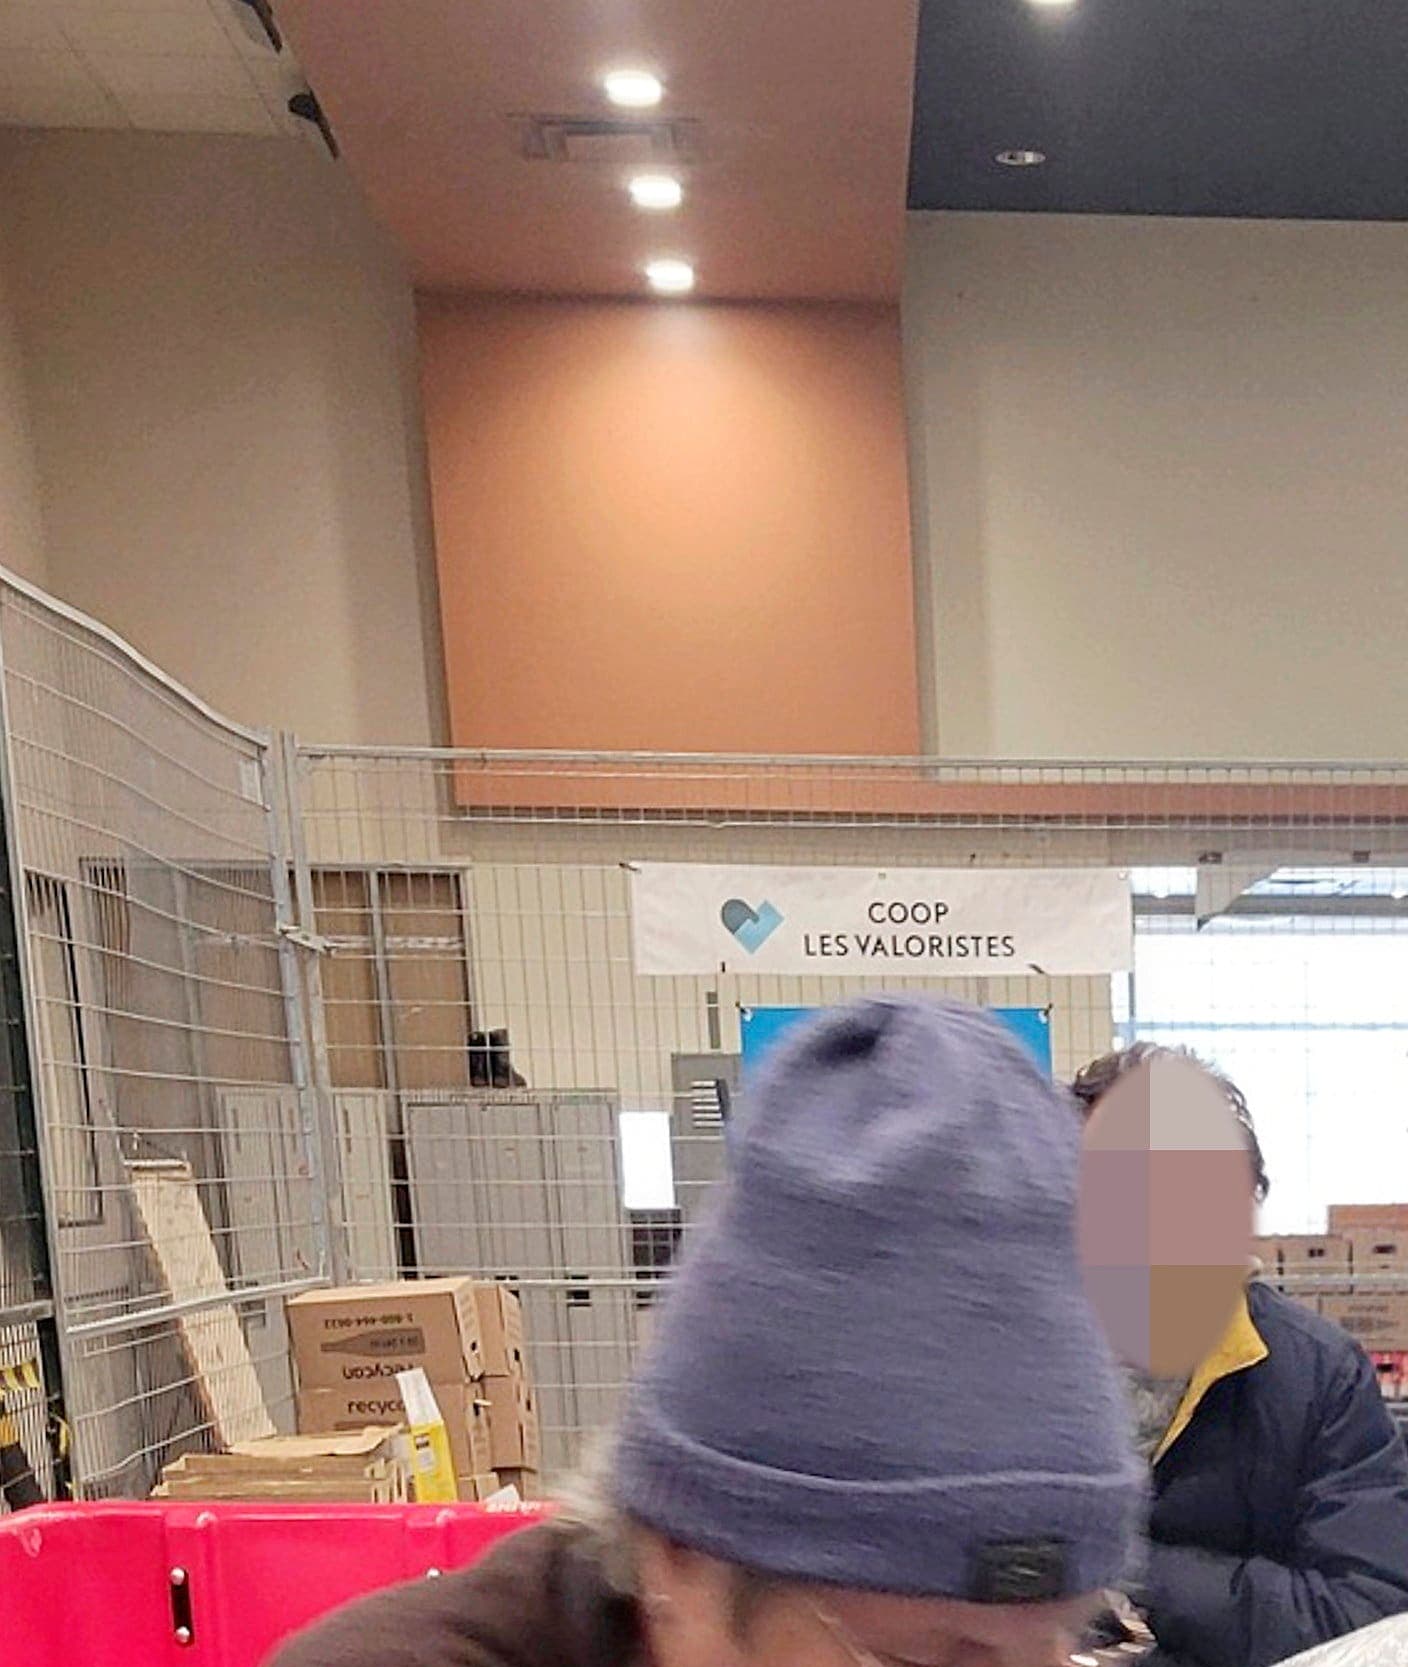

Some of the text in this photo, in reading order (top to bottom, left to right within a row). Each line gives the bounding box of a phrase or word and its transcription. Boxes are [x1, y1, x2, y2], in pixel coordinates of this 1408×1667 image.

[867, 901, 950, 926] COOP
[803, 934, 1016, 958] LES VALORISTES
